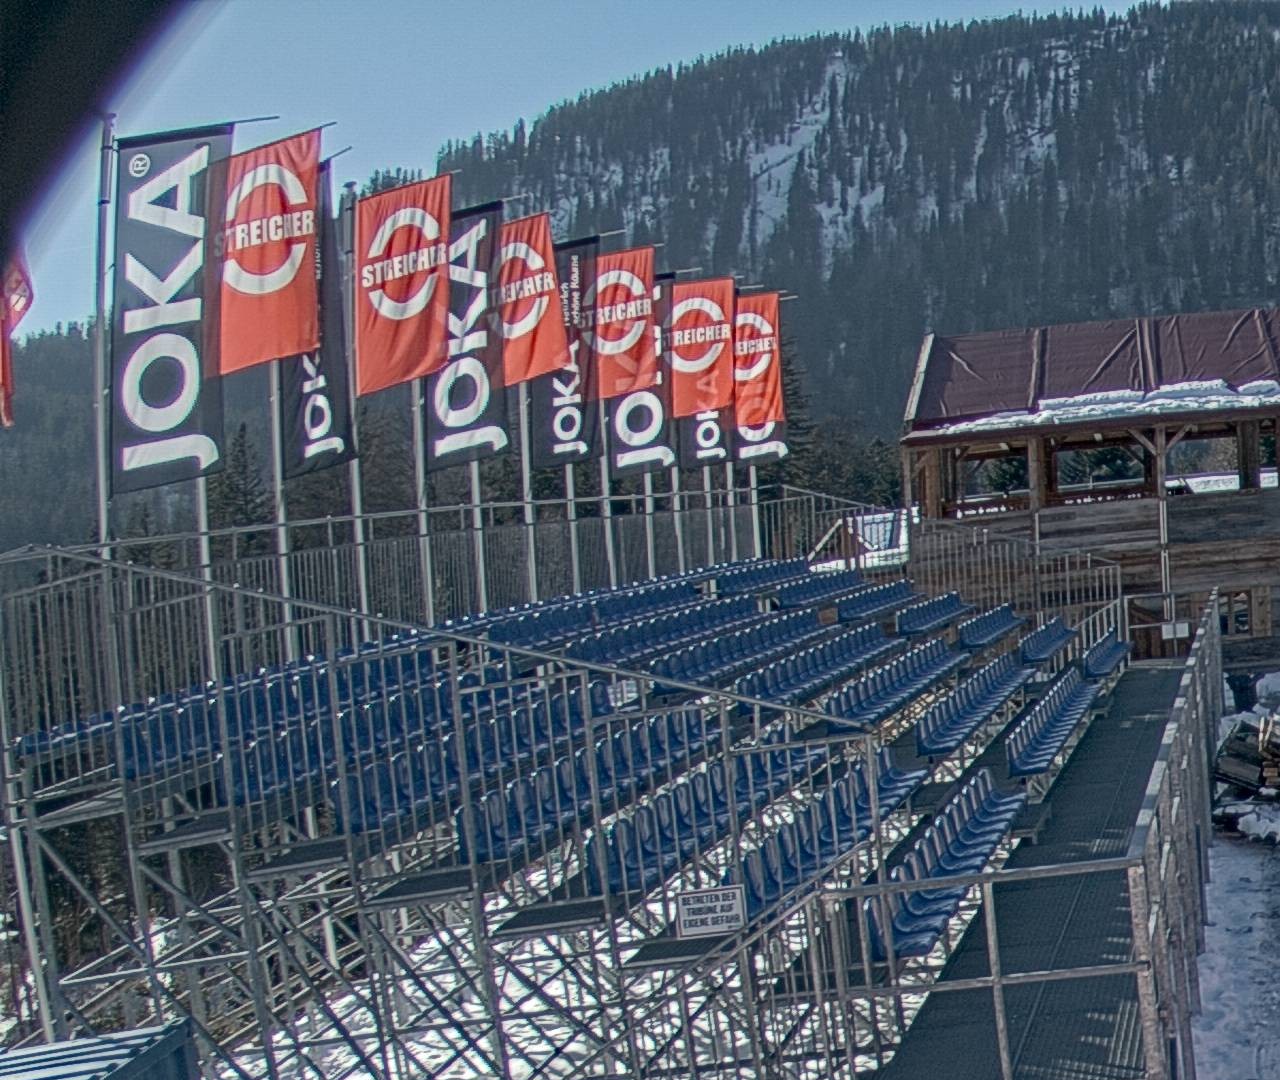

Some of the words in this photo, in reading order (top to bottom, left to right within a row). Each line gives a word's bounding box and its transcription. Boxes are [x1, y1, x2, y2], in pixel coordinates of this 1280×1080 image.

[213, 209, 315, 257] STREICHER
[362, 242, 447, 288] STREICHER
[122, 144, 220, 471] JOKA
[434, 217, 508, 457] JOKA
